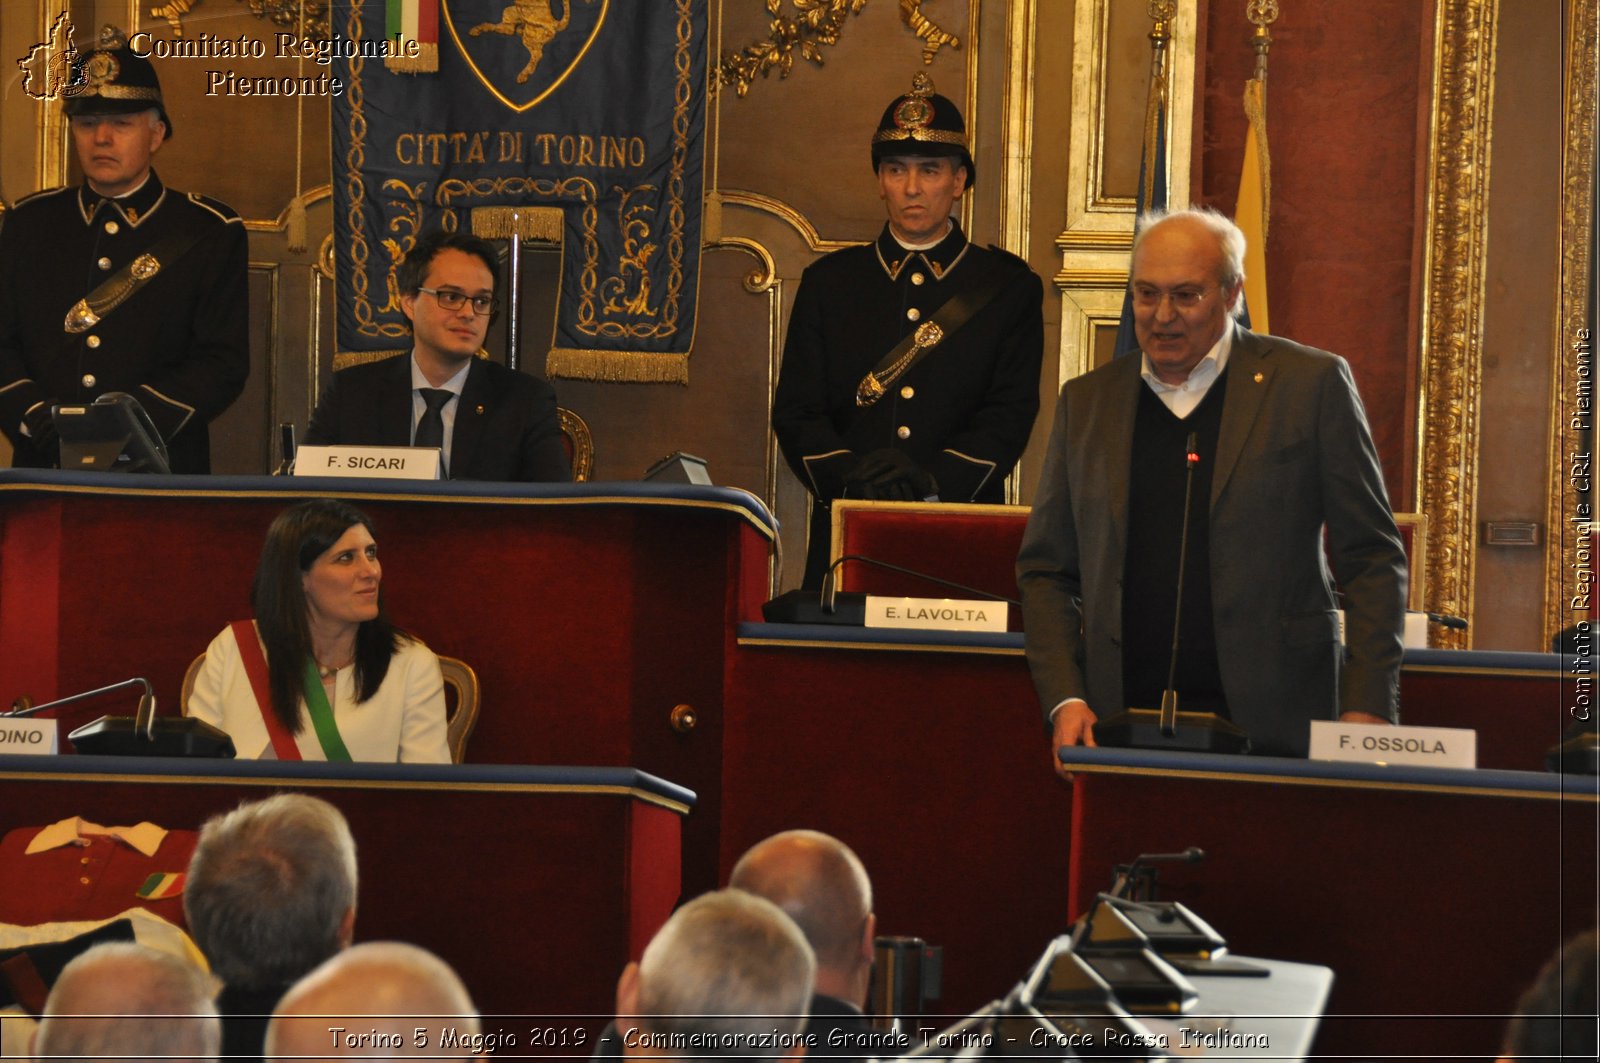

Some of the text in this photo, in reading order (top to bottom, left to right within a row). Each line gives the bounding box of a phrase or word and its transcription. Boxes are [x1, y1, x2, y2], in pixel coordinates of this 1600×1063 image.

[395, 131, 646, 169] CITTA' DI TORINO
[327, 455, 406, 470] F. SICARI
[885, 606, 988, 622] E. LAVOLTA
[1339, 735, 1447, 755] F. OSSOLA
